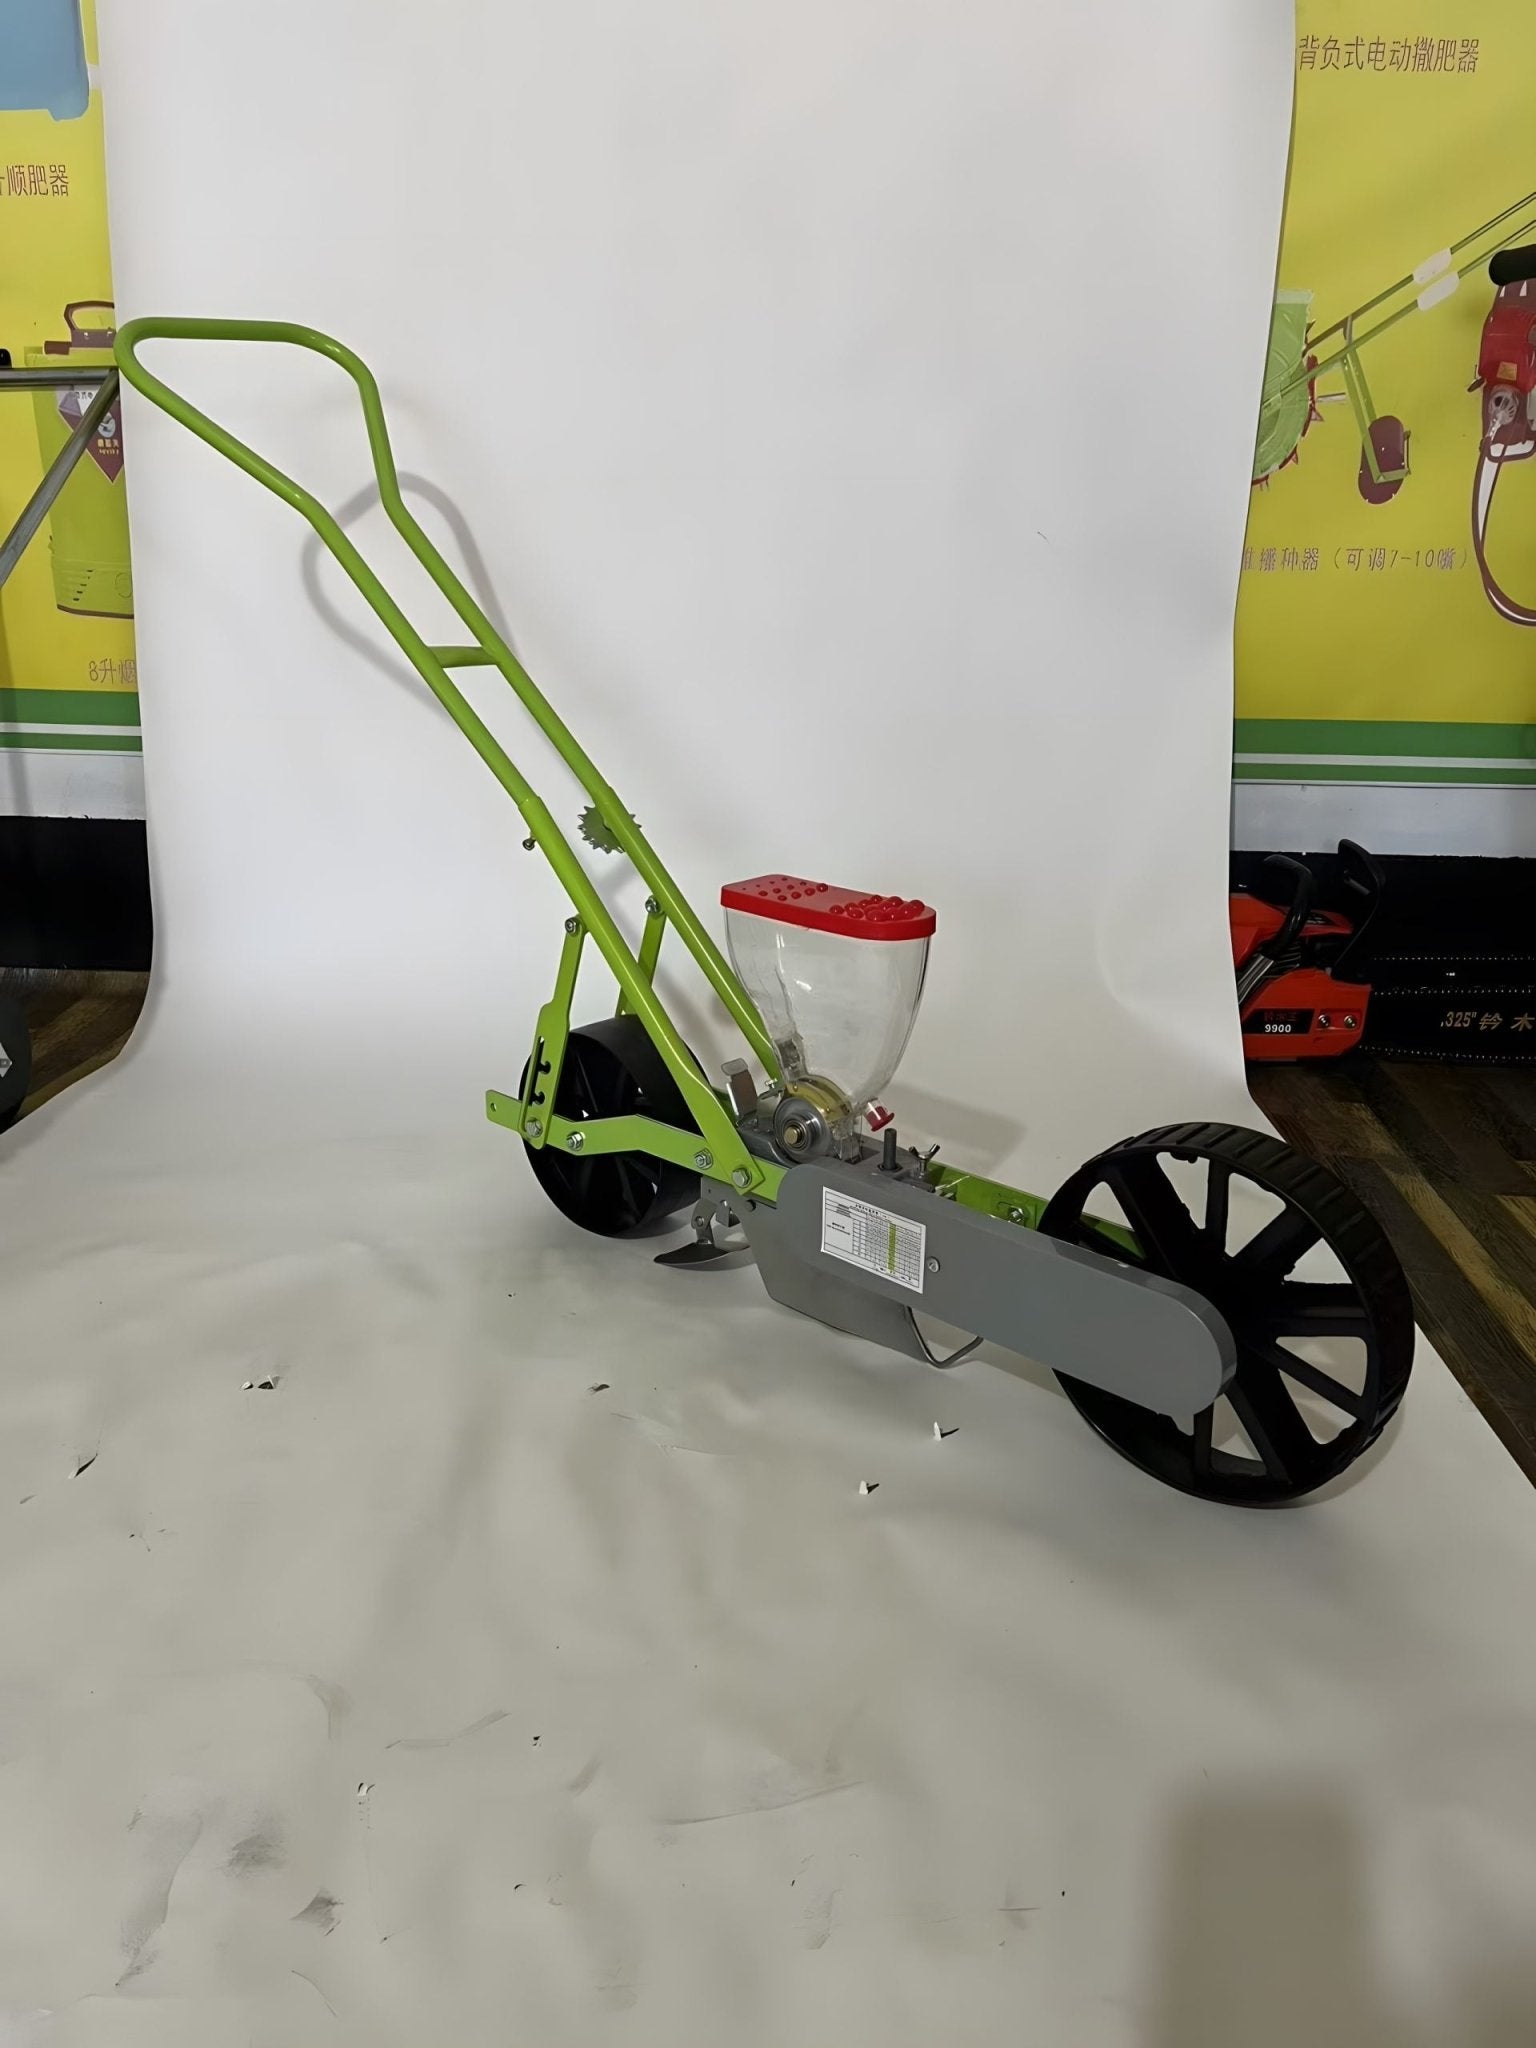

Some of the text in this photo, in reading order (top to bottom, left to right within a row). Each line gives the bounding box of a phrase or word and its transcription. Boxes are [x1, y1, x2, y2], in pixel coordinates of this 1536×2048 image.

[1298, 35, 1479, 73] 背负式电动撒肥器
[0, 164, 69, 197] 顺肥器
[1264, 1023, 1292, 1033] 9900
